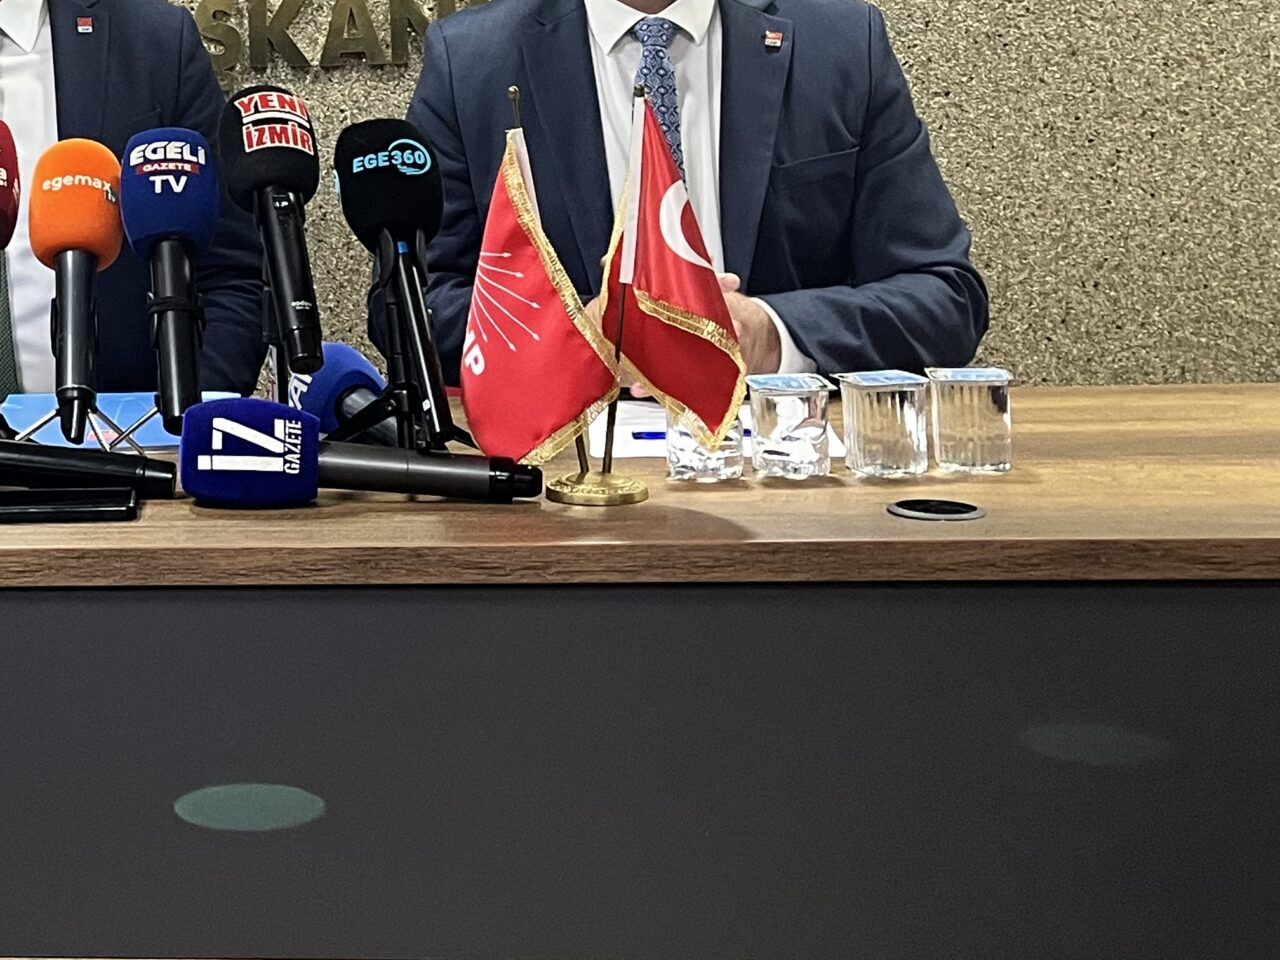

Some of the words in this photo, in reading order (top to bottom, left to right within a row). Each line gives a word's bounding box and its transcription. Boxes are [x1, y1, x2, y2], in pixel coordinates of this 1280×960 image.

[242, 121, 315, 156] İZMİR
[142, 162, 193, 172] GAZETE
[42, 174, 112, 191] egemax
[148, 174, 188, 194] TV
[283, 419, 302, 474] GAZETE
